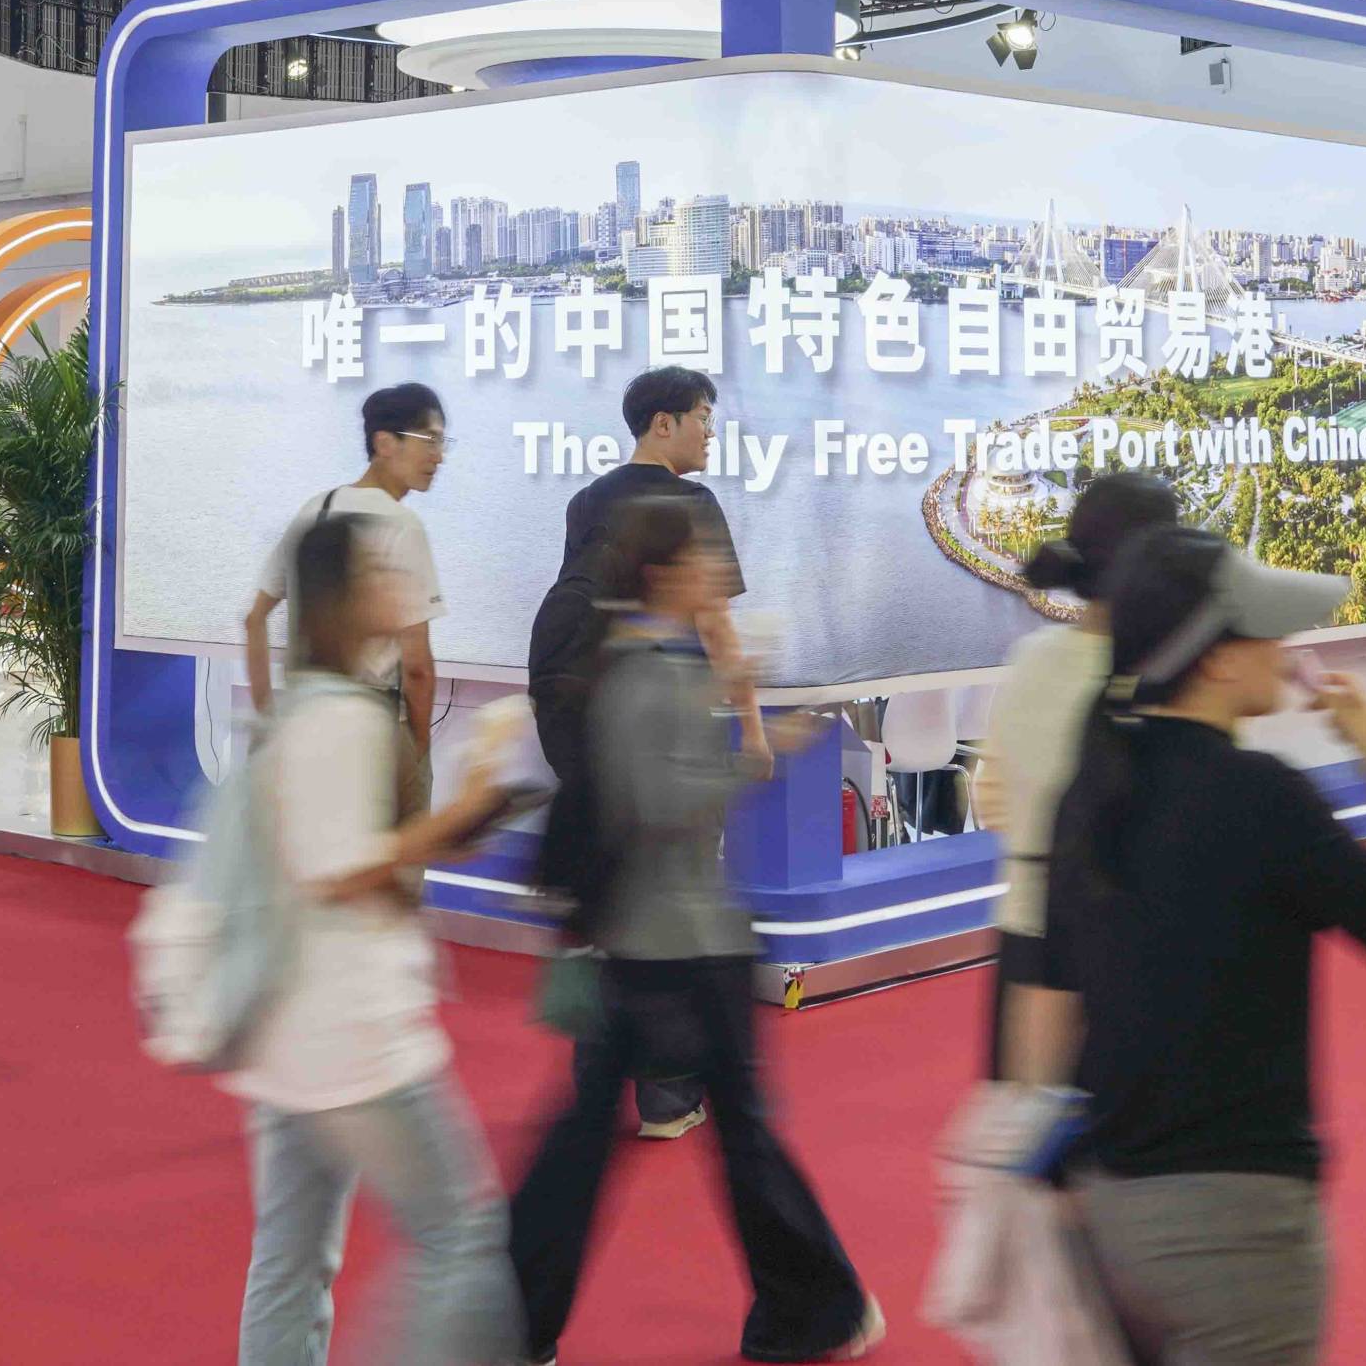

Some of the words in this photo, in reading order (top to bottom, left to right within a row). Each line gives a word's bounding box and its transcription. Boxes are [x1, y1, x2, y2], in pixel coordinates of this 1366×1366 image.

[302, 266, 1276, 384] 唯一的中国特色自由贸易港
[513, 420, 621, 476] The
[814, 419, 929, 476] Free
[944, 420, 1078, 472] Trade
[1093, 417, 1181, 469] Port
[1193, 416, 1274, 466] with
